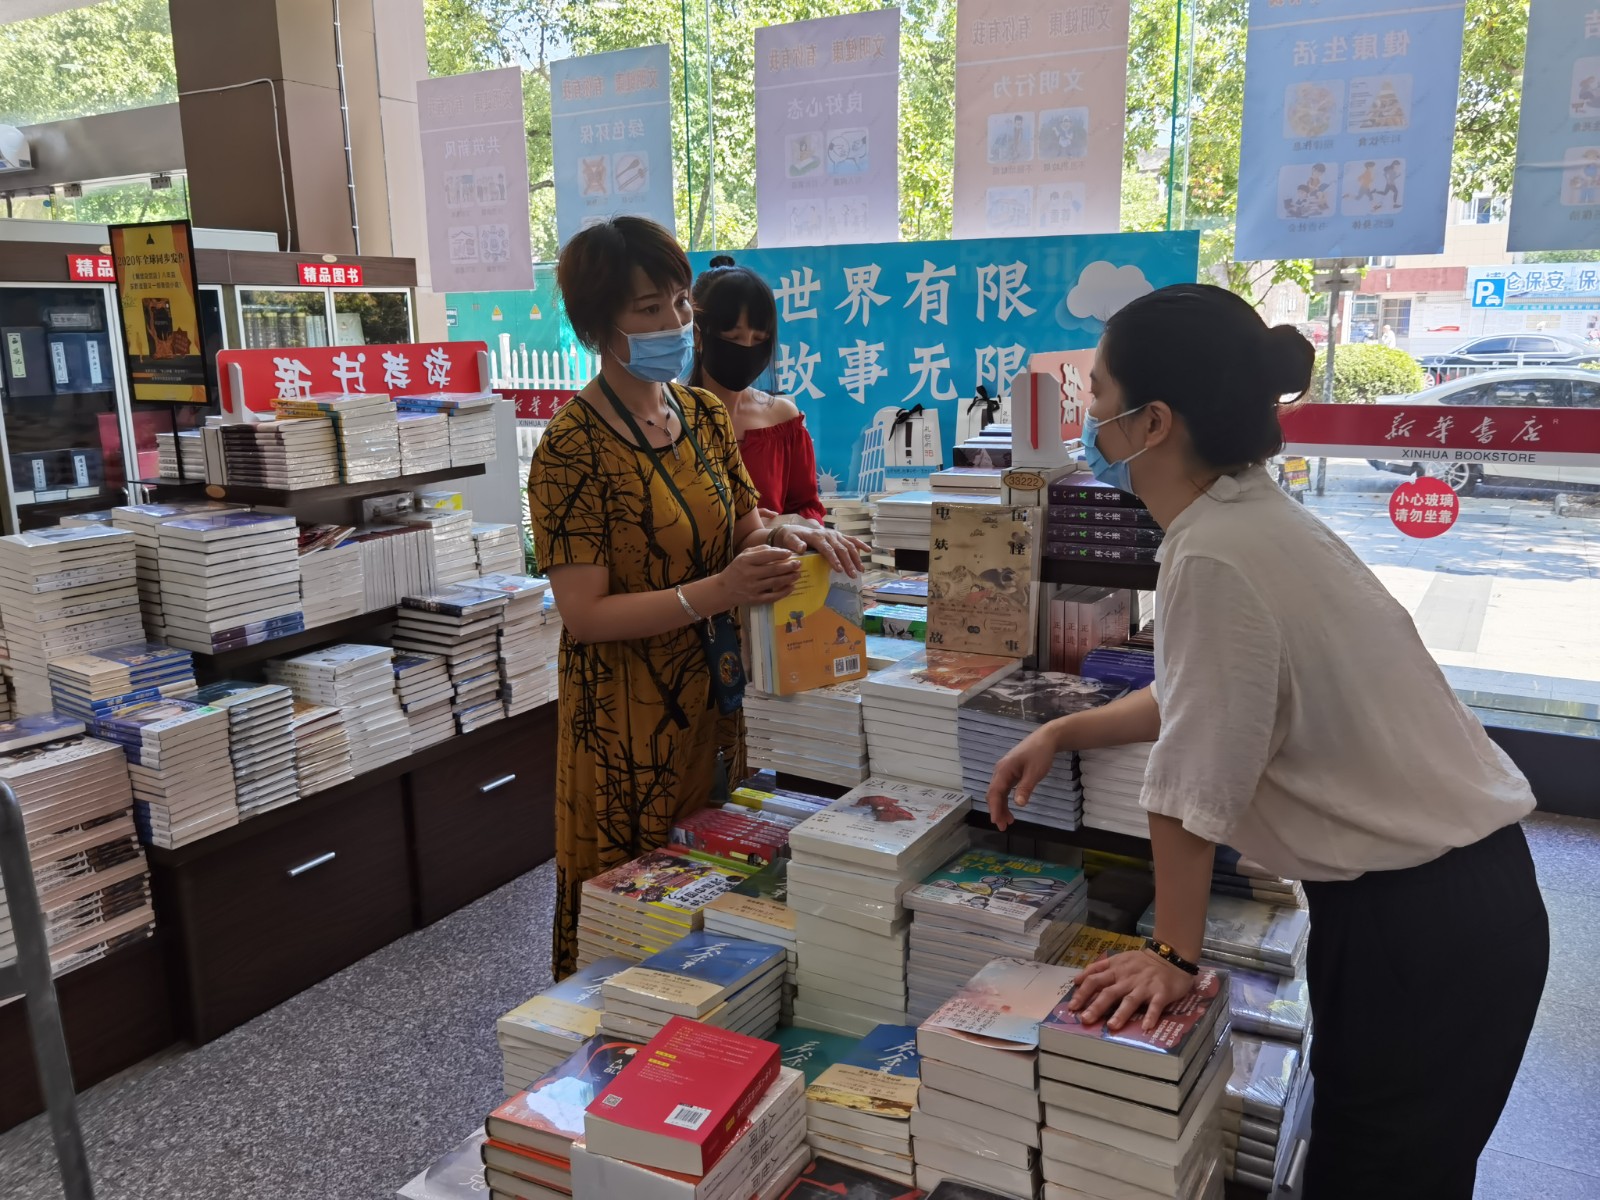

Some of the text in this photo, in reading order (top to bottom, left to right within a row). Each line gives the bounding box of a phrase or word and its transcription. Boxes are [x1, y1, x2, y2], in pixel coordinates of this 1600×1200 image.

[76, 258, 115, 278] 精品
[303, 266, 359, 285] 精品图书
[1487, 270, 1566, 292] 仑保安
[773, 259, 1037, 327] 世界有限
[776, 339, 1030, 404] 故事无限
[1401, 448, 1537, 463] XINHUA BOOKSTORE
[1008, 475, 1040, 486] 33222
[1395, 492, 1455, 508] 小心玻璃
[1394, 508, 1453, 524] 请勿坐靠
